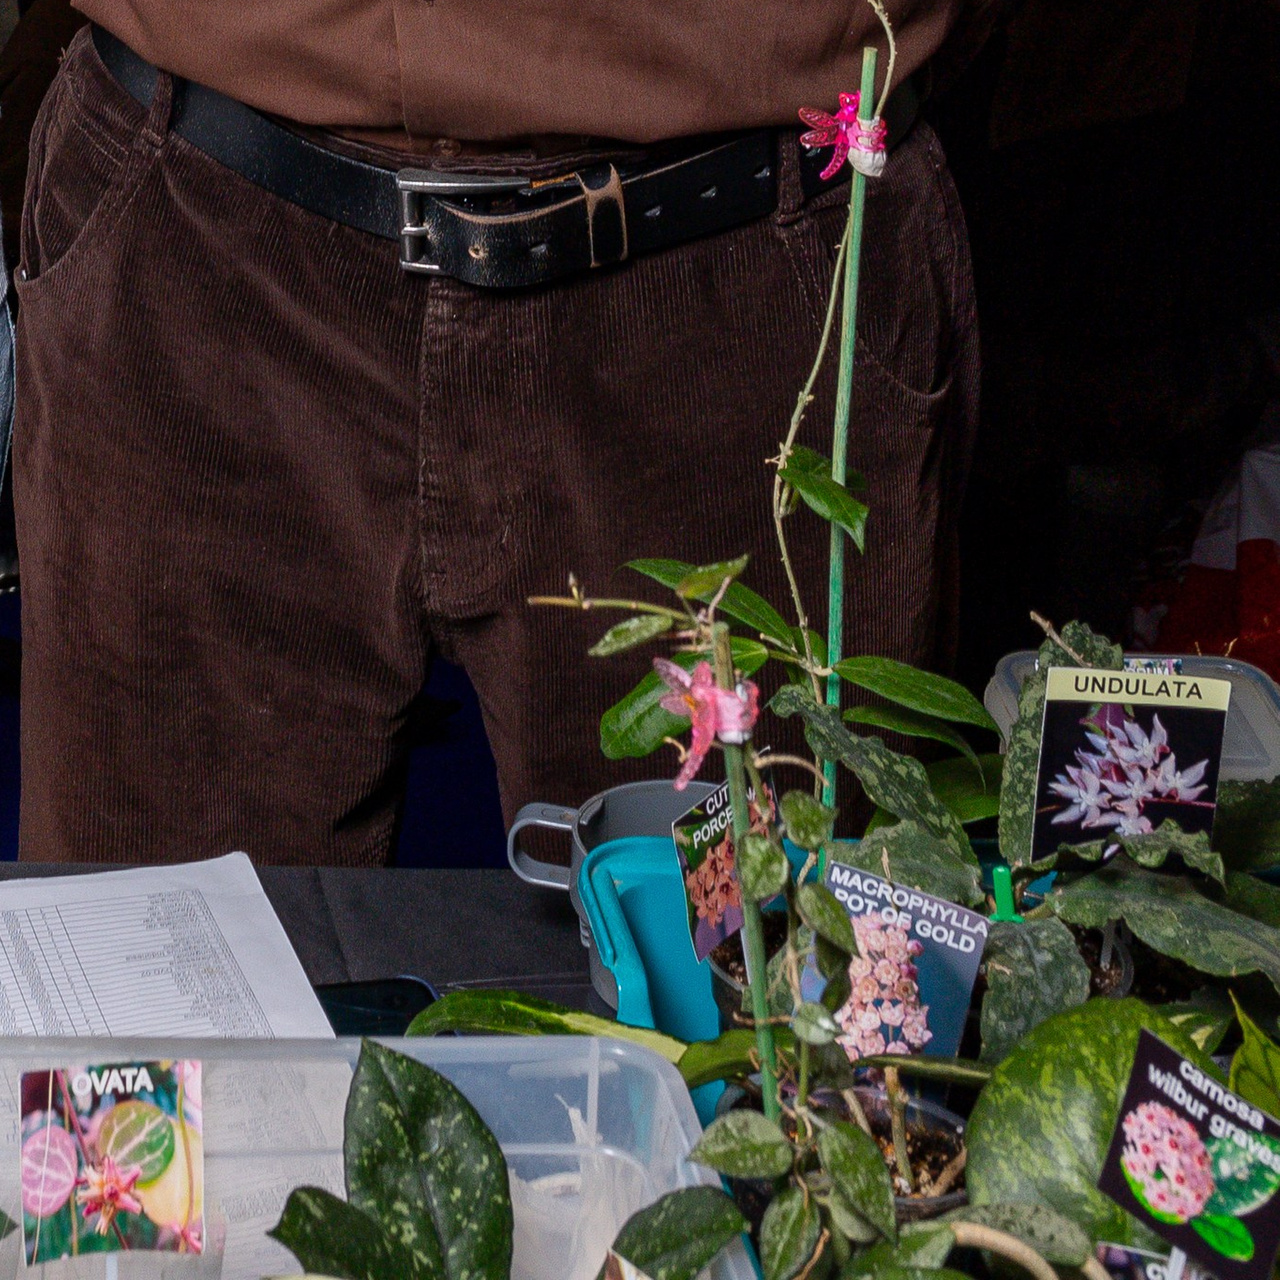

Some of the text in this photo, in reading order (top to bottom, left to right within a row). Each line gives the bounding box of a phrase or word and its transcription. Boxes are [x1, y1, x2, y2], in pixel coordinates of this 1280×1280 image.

[1074, 675, 1202, 700] UNDULATA
[706, 784, 730, 815] CUT
[831, 866, 988, 938] MACROPHYLLA
[834, 888, 976, 953] POT OF GOLD
[71, 1066, 154, 1096] OVATA
[1148, 1063, 1208, 1121] wilbur
[1179, 1060, 1265, 1130] carnosa
